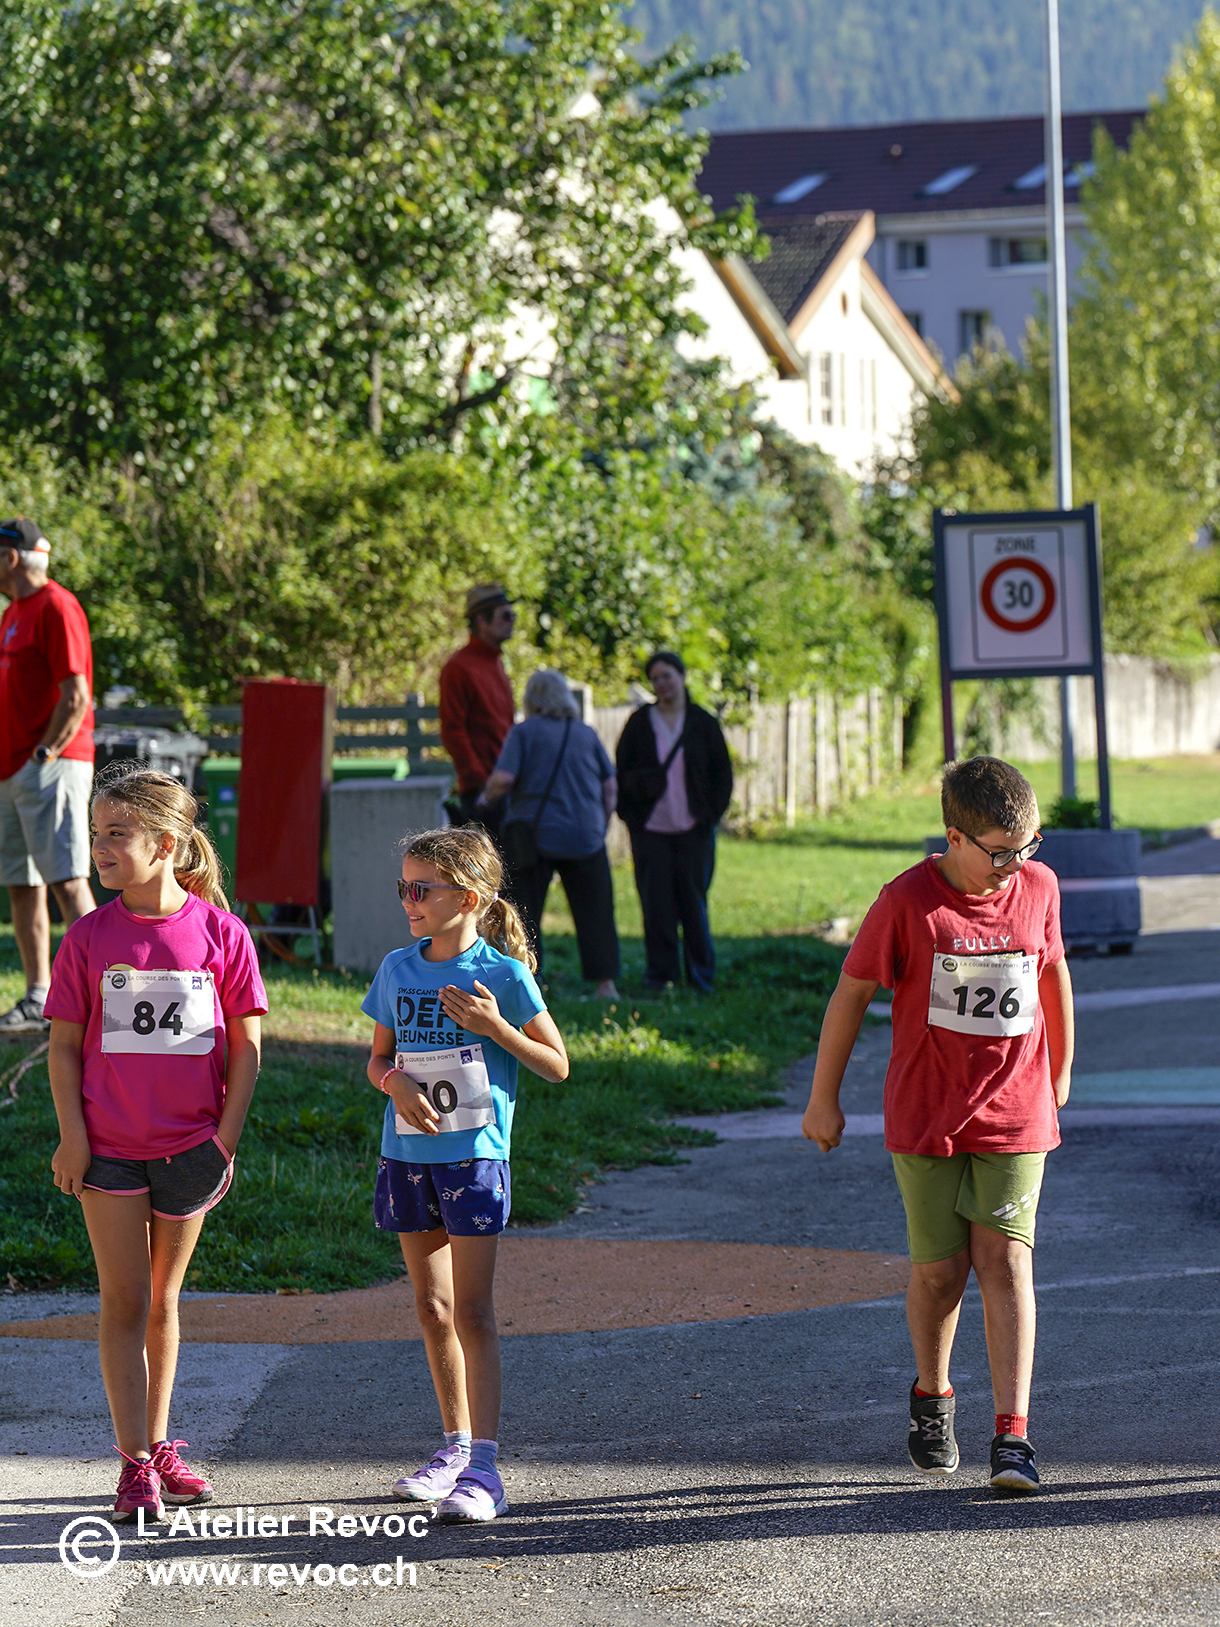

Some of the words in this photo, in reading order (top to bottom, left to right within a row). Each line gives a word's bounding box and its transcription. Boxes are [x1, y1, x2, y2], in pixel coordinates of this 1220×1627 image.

[995, 536, 1035, 553] ZONE
[1003, 581, 1034, 610] 30
[954, 936, 1010, 950] FULLY
[953, 985, 1020, 1019] 126
[132, 1000, 183, 1035] 84
[398, 1030, 464, 1045] JEUNESSE
[419, 1080, 458, 1114] 0
